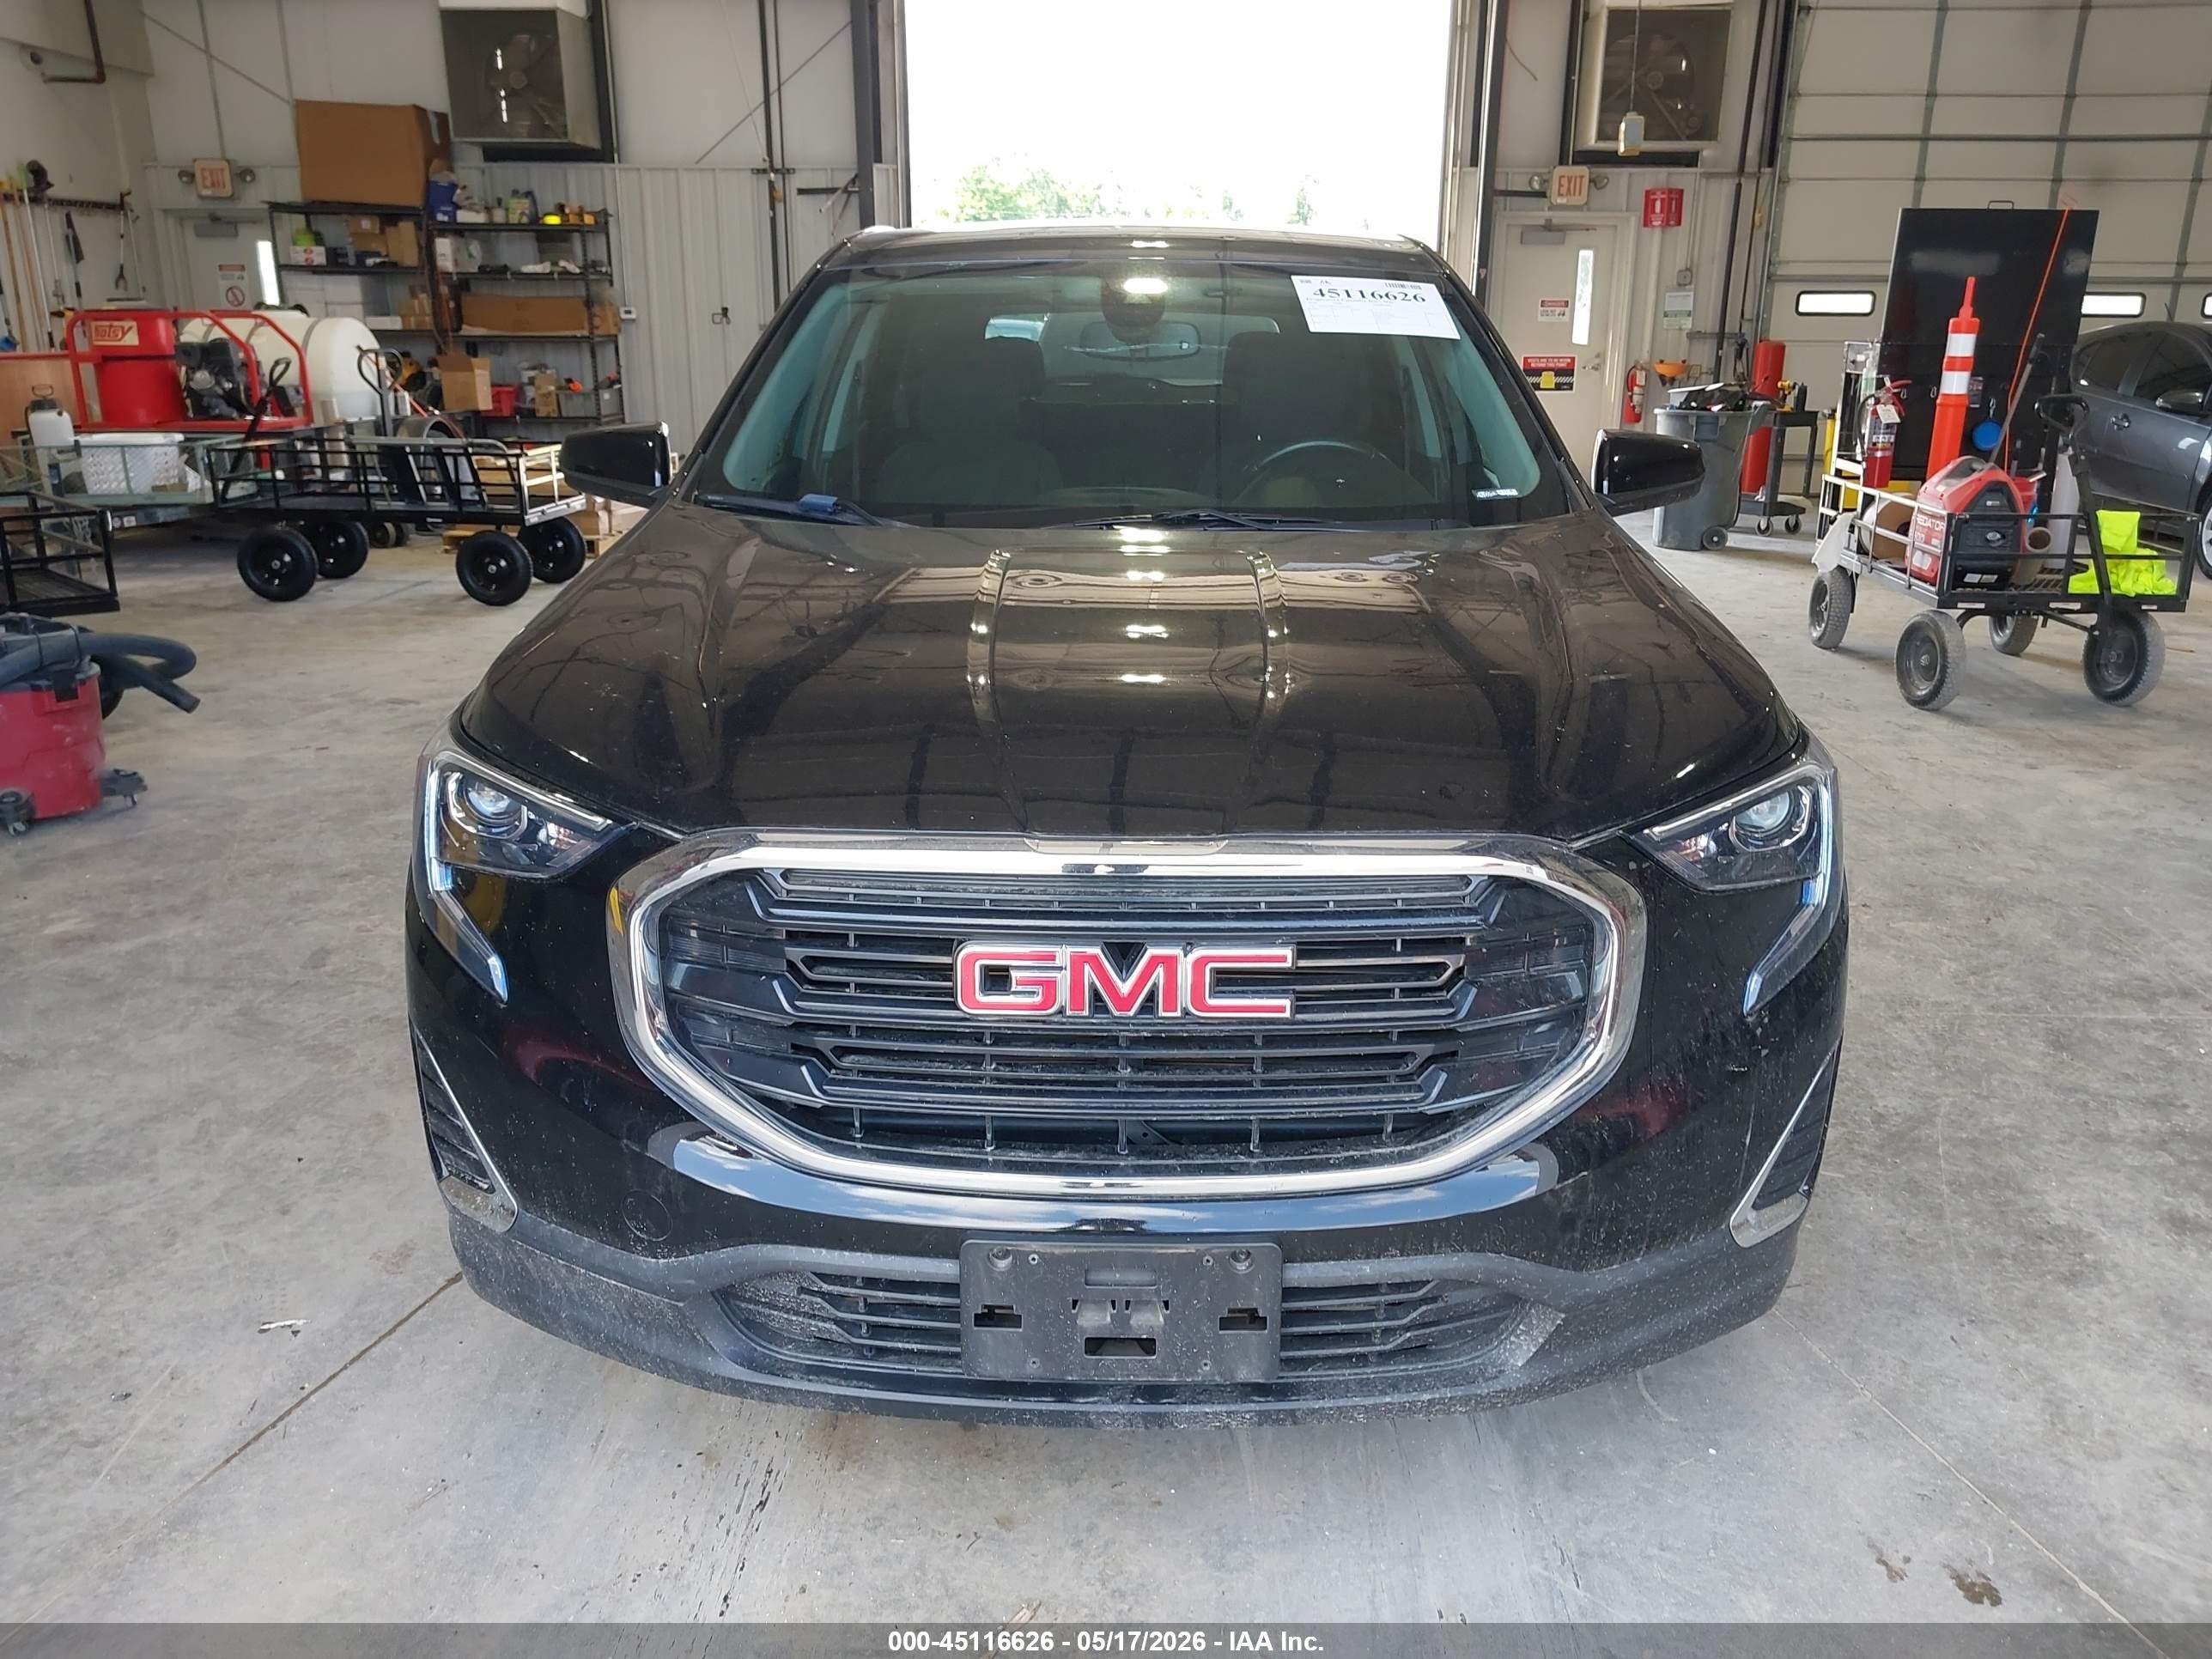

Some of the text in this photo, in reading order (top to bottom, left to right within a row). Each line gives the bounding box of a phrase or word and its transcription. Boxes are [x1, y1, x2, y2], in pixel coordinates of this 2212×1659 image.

[201, 167, 226, 188] EXIT
[1557, 175, 1585, 197] EXIT
[1313, 288, 1426, 302] 45116626
[955, 941, 1297, 1018] GMC
